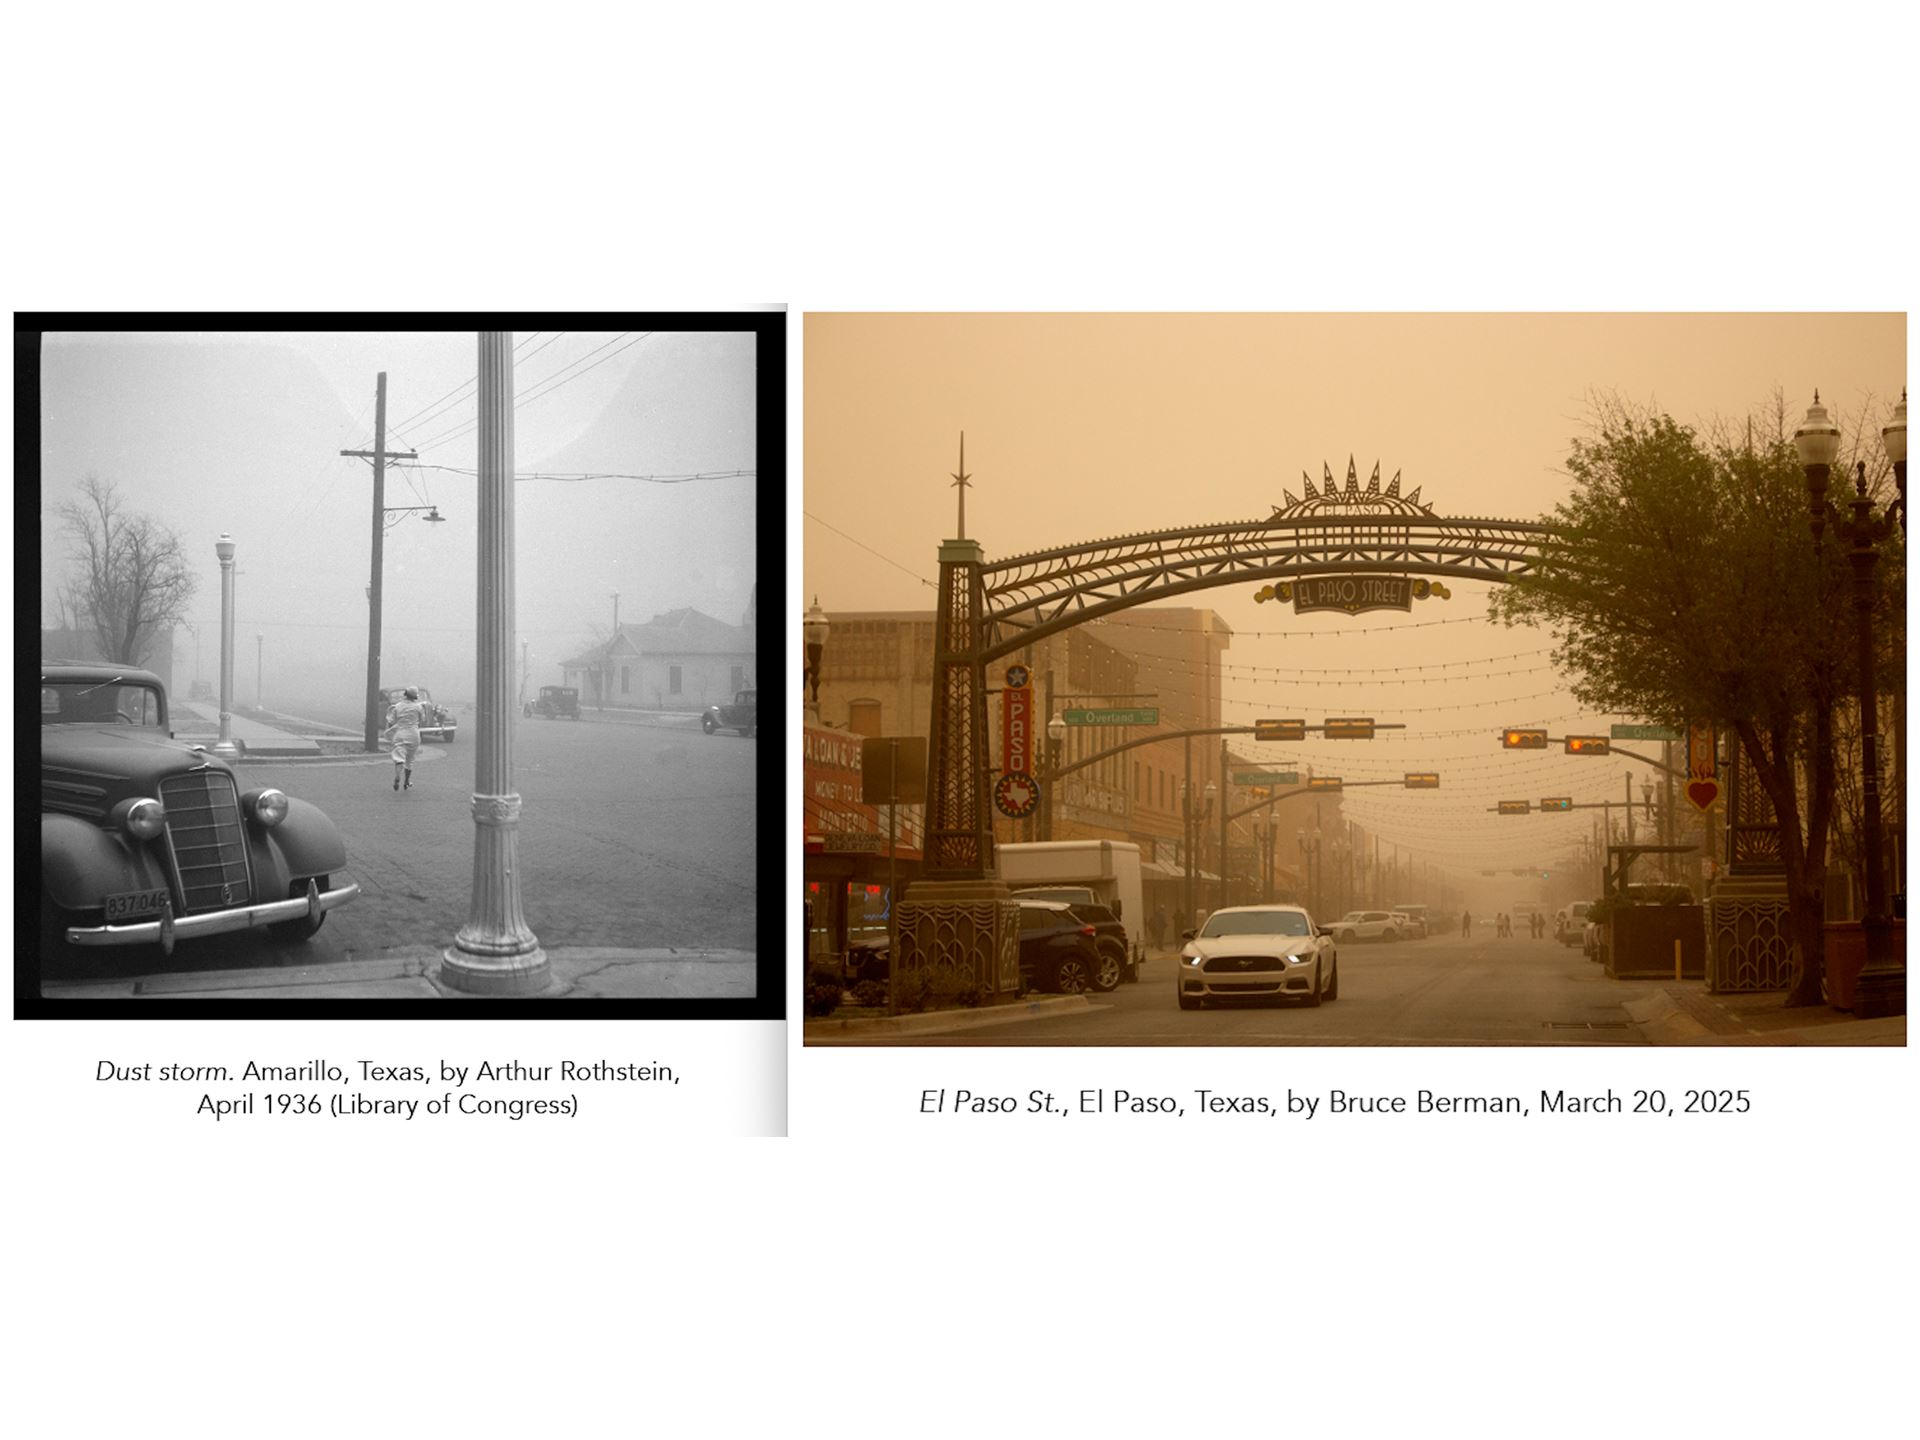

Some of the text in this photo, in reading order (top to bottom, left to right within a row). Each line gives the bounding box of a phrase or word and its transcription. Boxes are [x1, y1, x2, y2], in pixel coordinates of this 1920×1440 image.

[1345, 504, 1382, 516] PASO
[1298, 580, 1405, 605] EL PASO STREET
[1010, 692, 1024, 702] EL
[1085, 711, 1134, 723] Overland
[1010, 703, 1024, 771] PASO
[814, 737, 839, 766] LOAN
